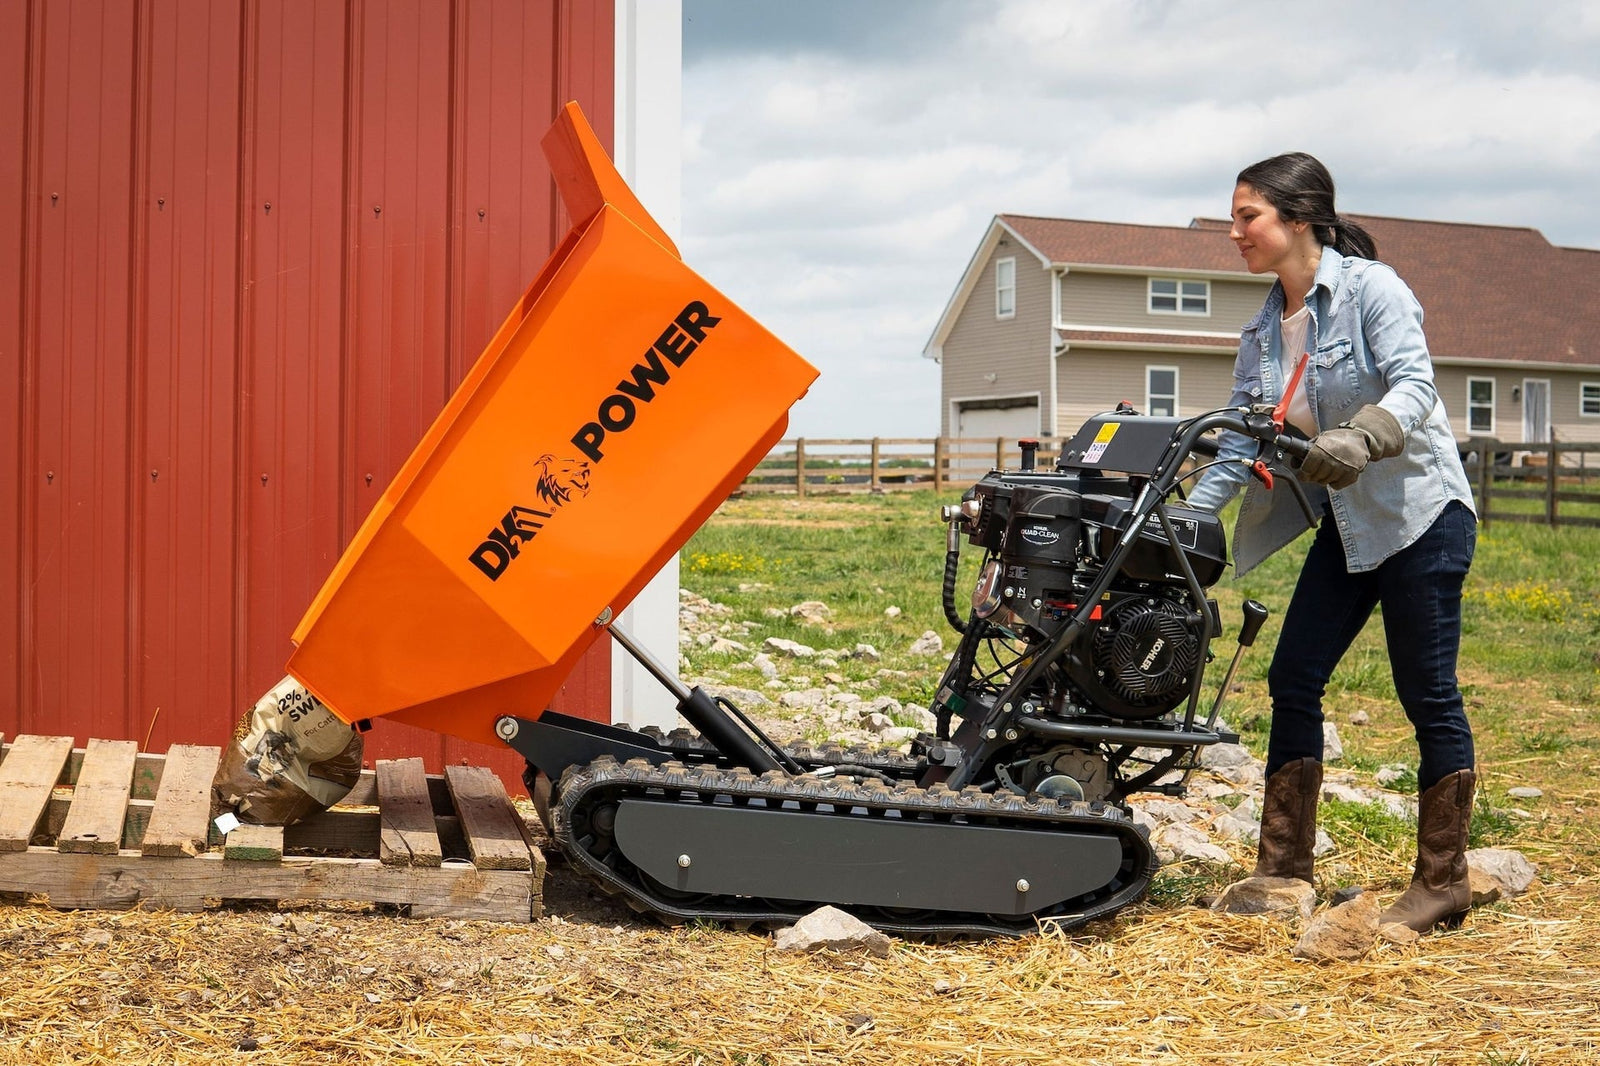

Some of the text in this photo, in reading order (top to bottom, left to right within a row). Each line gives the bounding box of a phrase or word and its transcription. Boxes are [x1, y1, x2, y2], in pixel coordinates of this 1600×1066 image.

[571, 301, 722, 463] POWER
[1021, 529, 1060, 539] QUAD-CLEAN
[1139, 638, 1165, 670] KOHLER
[303, 727, 318, 737] For
